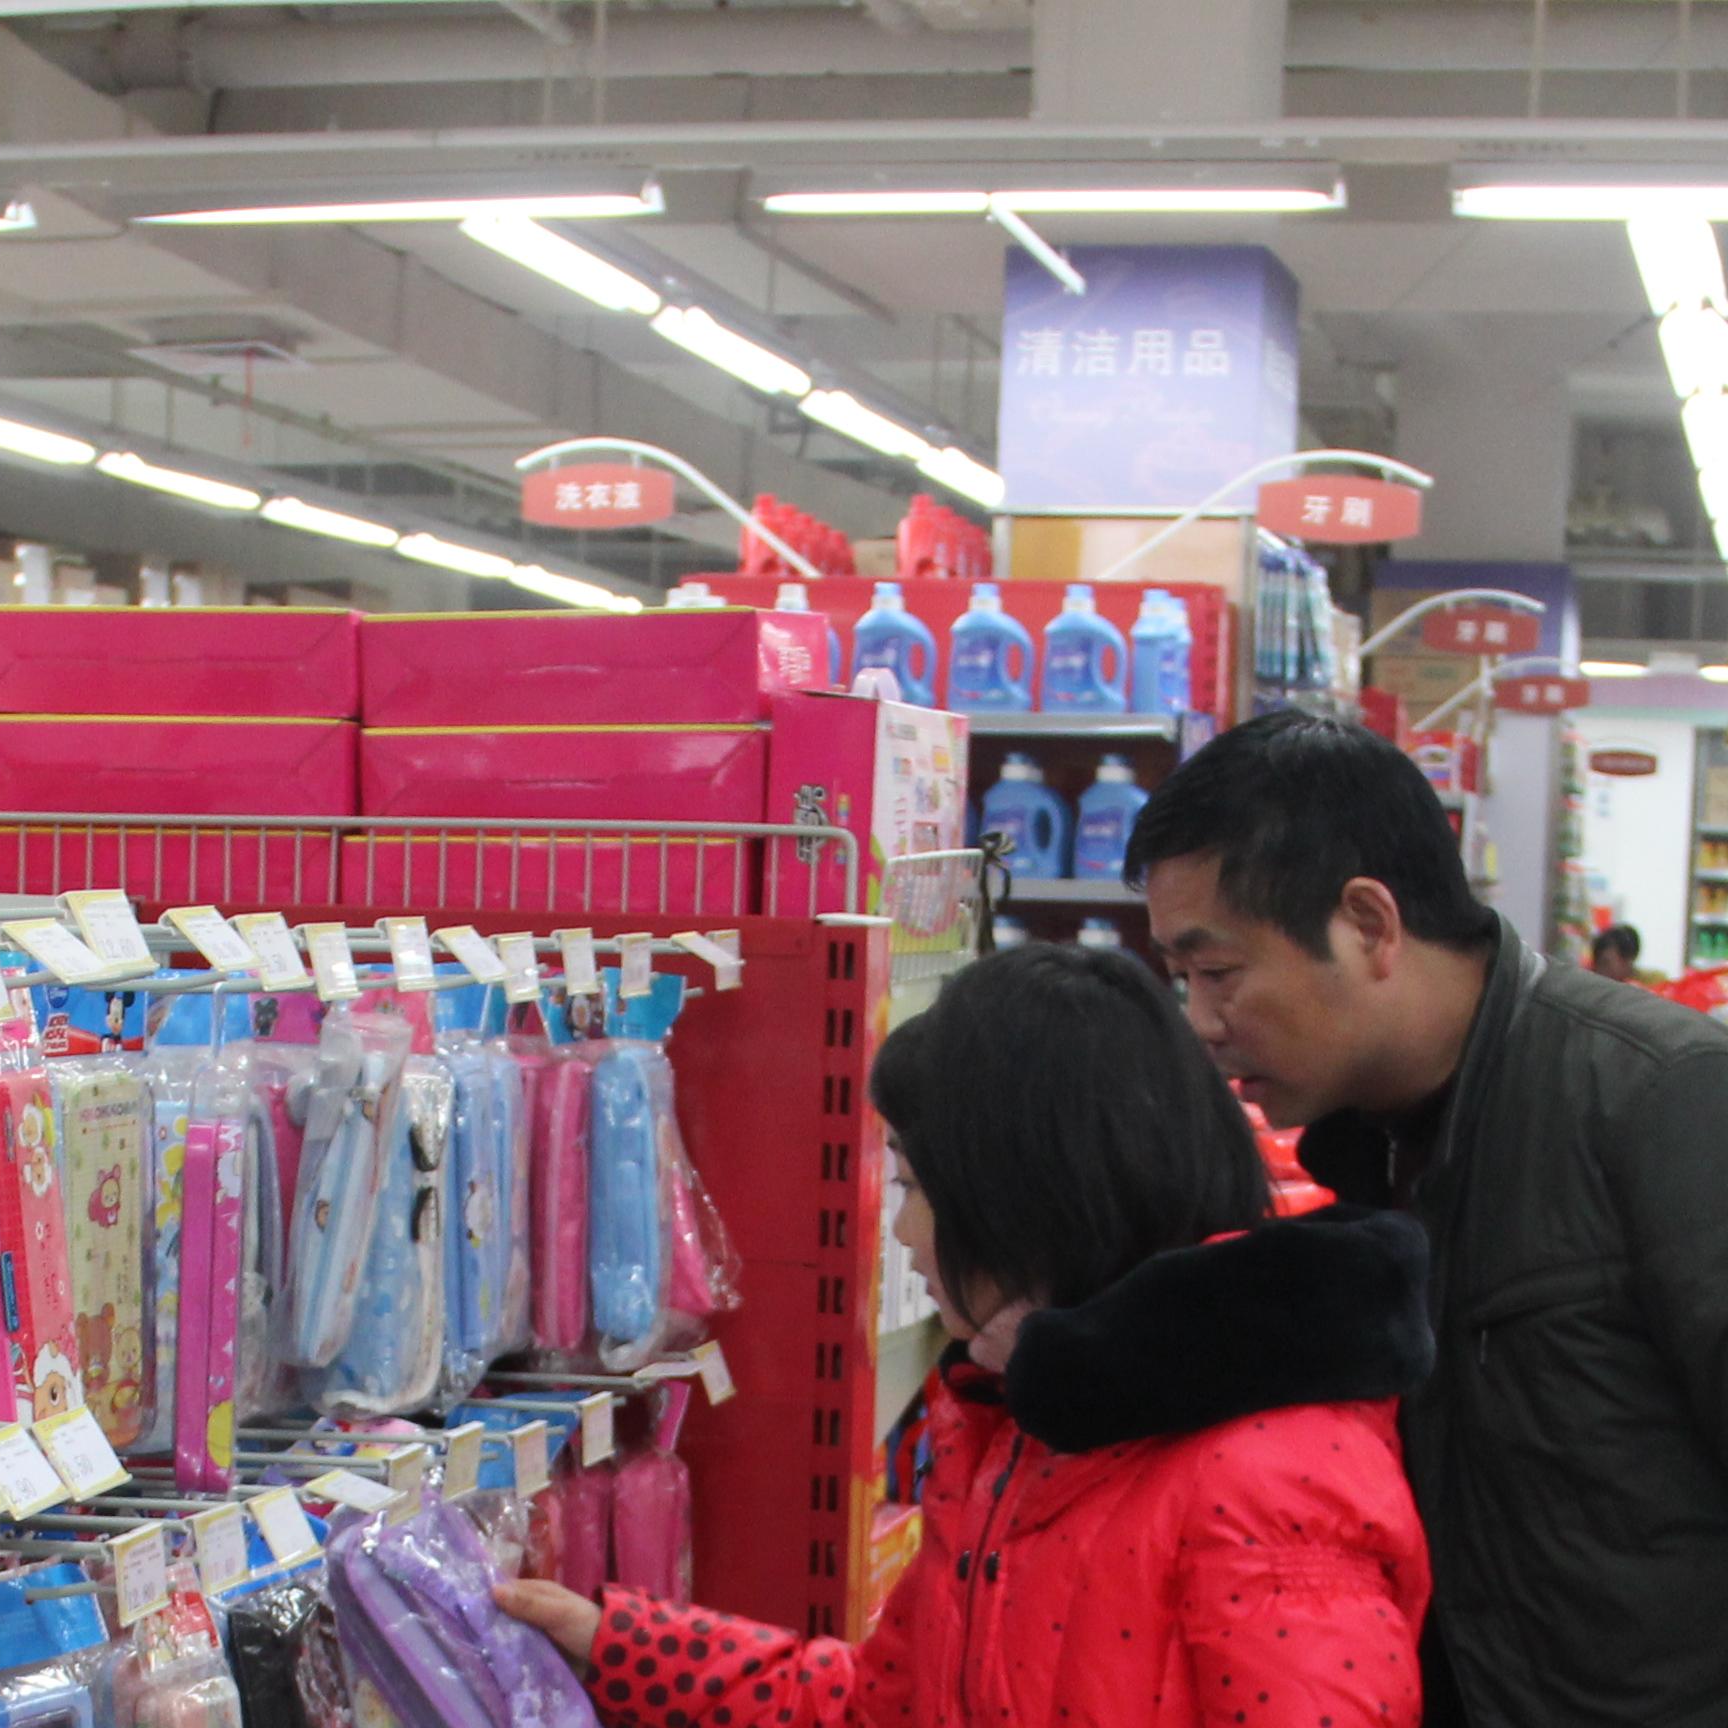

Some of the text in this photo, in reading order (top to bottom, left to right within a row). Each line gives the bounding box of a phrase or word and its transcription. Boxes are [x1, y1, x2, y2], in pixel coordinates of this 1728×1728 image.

[1016, 329, 1230, 377] 清洁用品
[555, 481, 641, 511] 洗衣液
[1301, 495, 1374, 527] 牙刷
